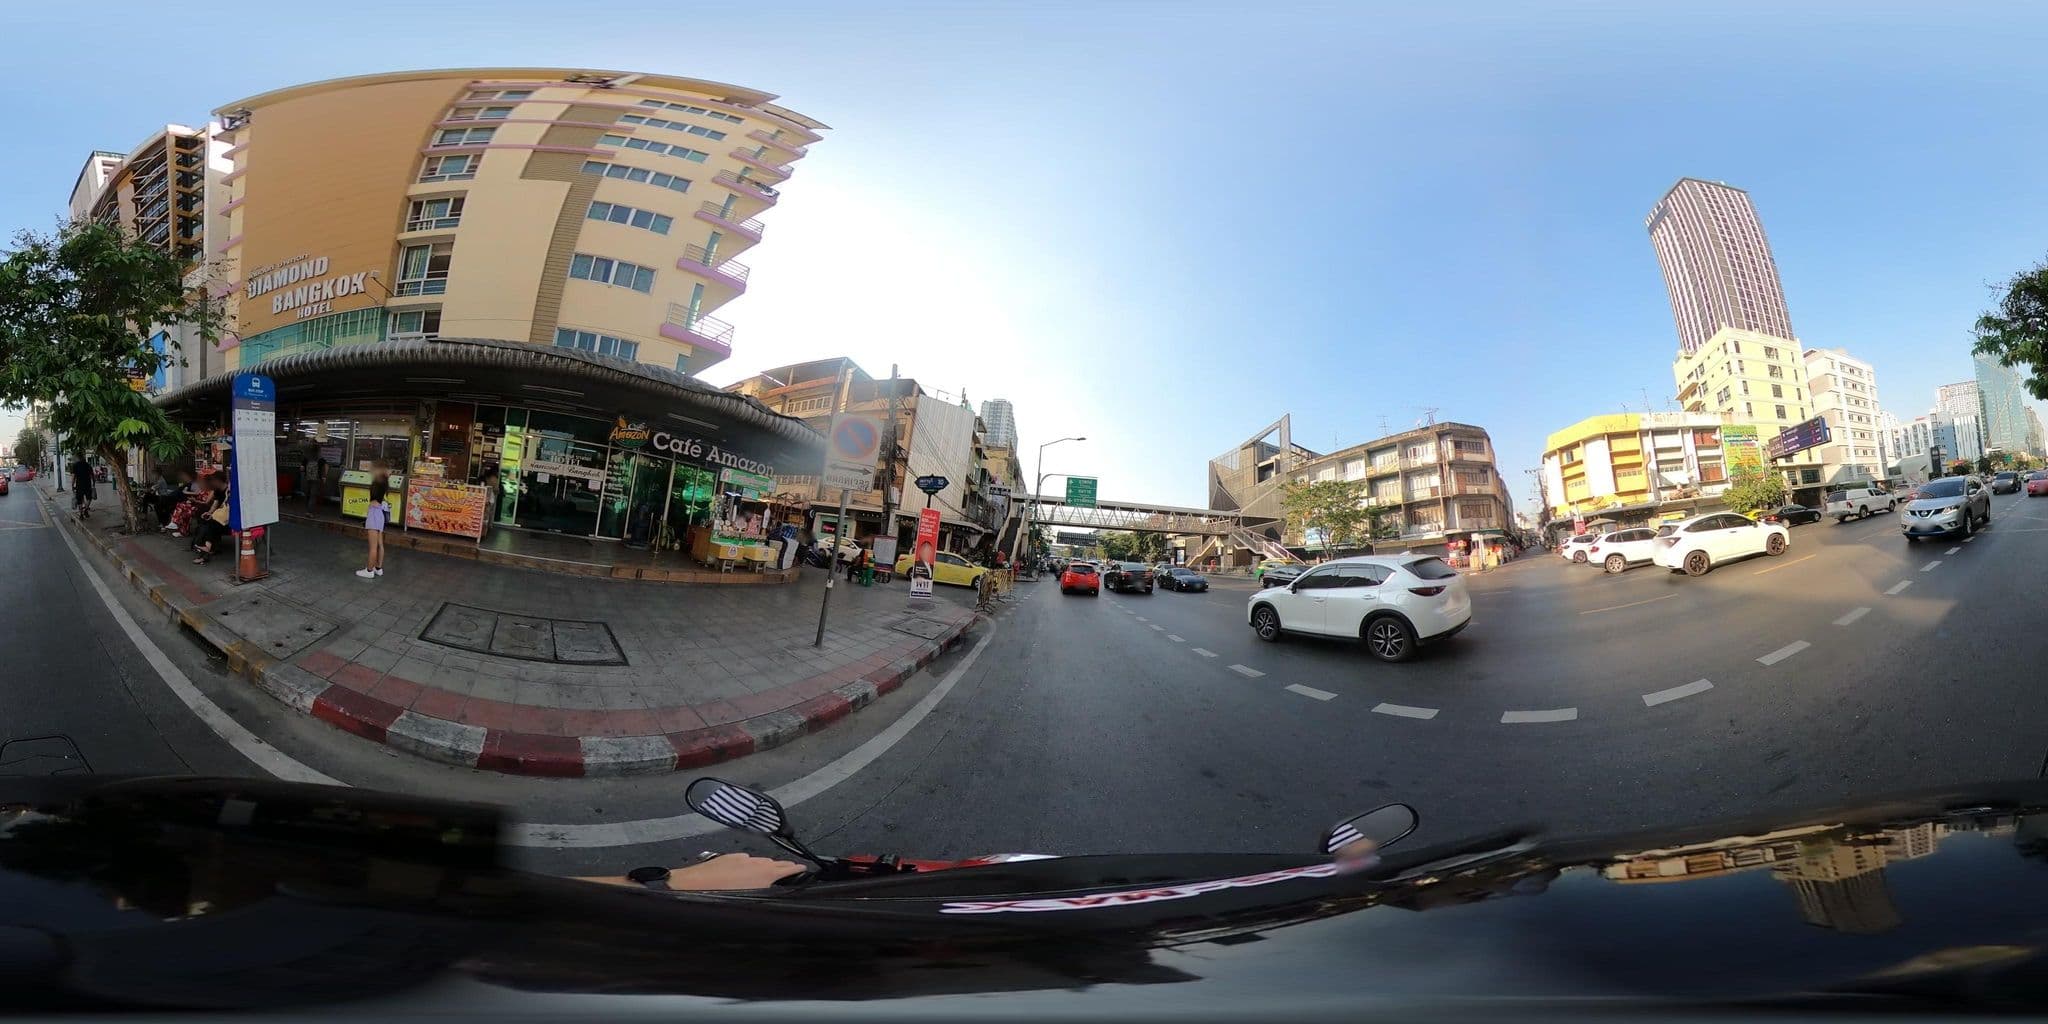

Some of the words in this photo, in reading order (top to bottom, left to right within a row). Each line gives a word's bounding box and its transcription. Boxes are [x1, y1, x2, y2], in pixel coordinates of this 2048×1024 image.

[248, 256, 329, 299] DIAMOND
[272, 271, 368, 314] BANGKOK
[297, 301, 334, 319] HOTEL
[653, 431, 702, 458] Café
[705, 444, 774, 477] Amazon
